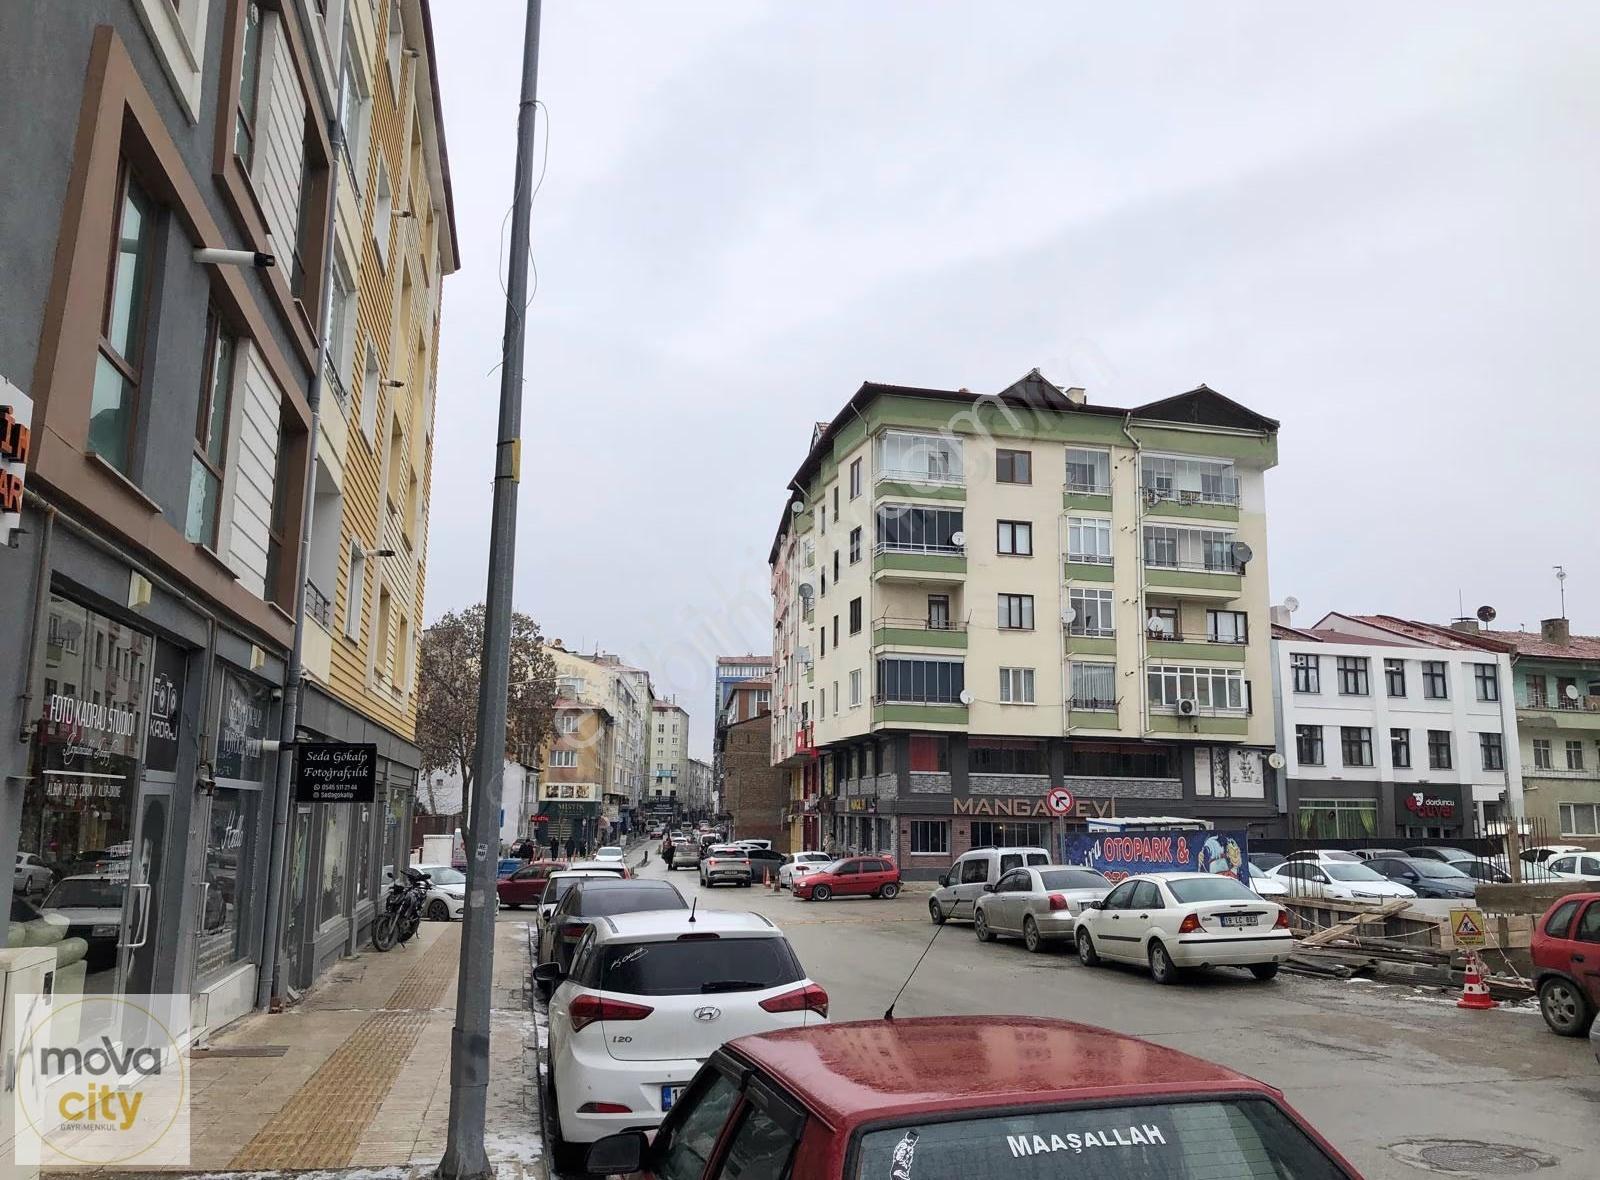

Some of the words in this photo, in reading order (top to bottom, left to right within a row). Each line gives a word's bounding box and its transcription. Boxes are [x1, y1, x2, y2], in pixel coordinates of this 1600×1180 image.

[0, 469, 24, 513] AR
[50, 694, 74, 724] FOTO
[75, 700, 107, 730] KADRAJ
[108, 708, 134, 736] STUDIO
[306, 750, 330, 761] Seda
[333, 750, 368, 765] Gökalp
[953, 797, 1061, 817] MANGA
[1104, 837, 1173, 863] OTOPARK
[1177, 837, 1190, 864] &
[1006, 1124, 1167, 1158] MAAŞALLAH
